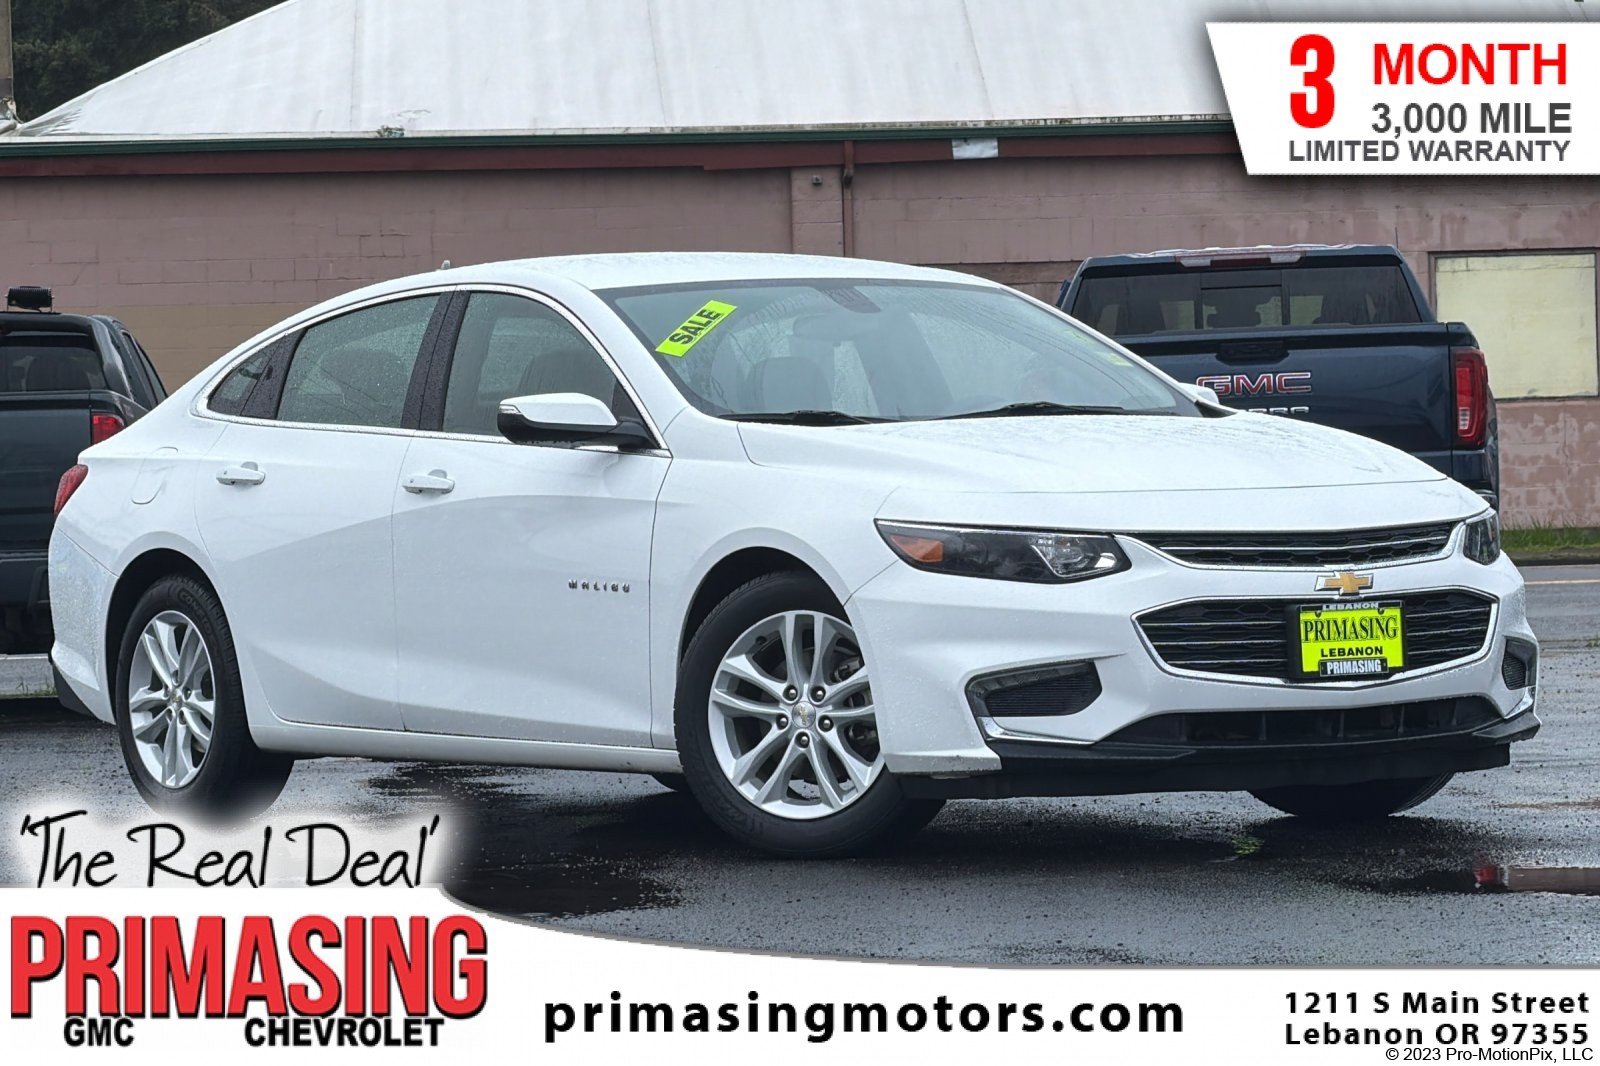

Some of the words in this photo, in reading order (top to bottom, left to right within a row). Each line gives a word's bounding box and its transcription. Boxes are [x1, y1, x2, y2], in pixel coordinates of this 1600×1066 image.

[669, 309, 724, 345] SALE
[1196, 372, 1311, 396] GMC
[568, 579, 630, 593] MALIBU
[1321, 602, 1378, 611] LEBANON
[1302, 616, 1399, 643] PRIMASING
[1321, 646, 1383, 657] LEBANON
[1326, 660, 1382, 674] PRIMASING
